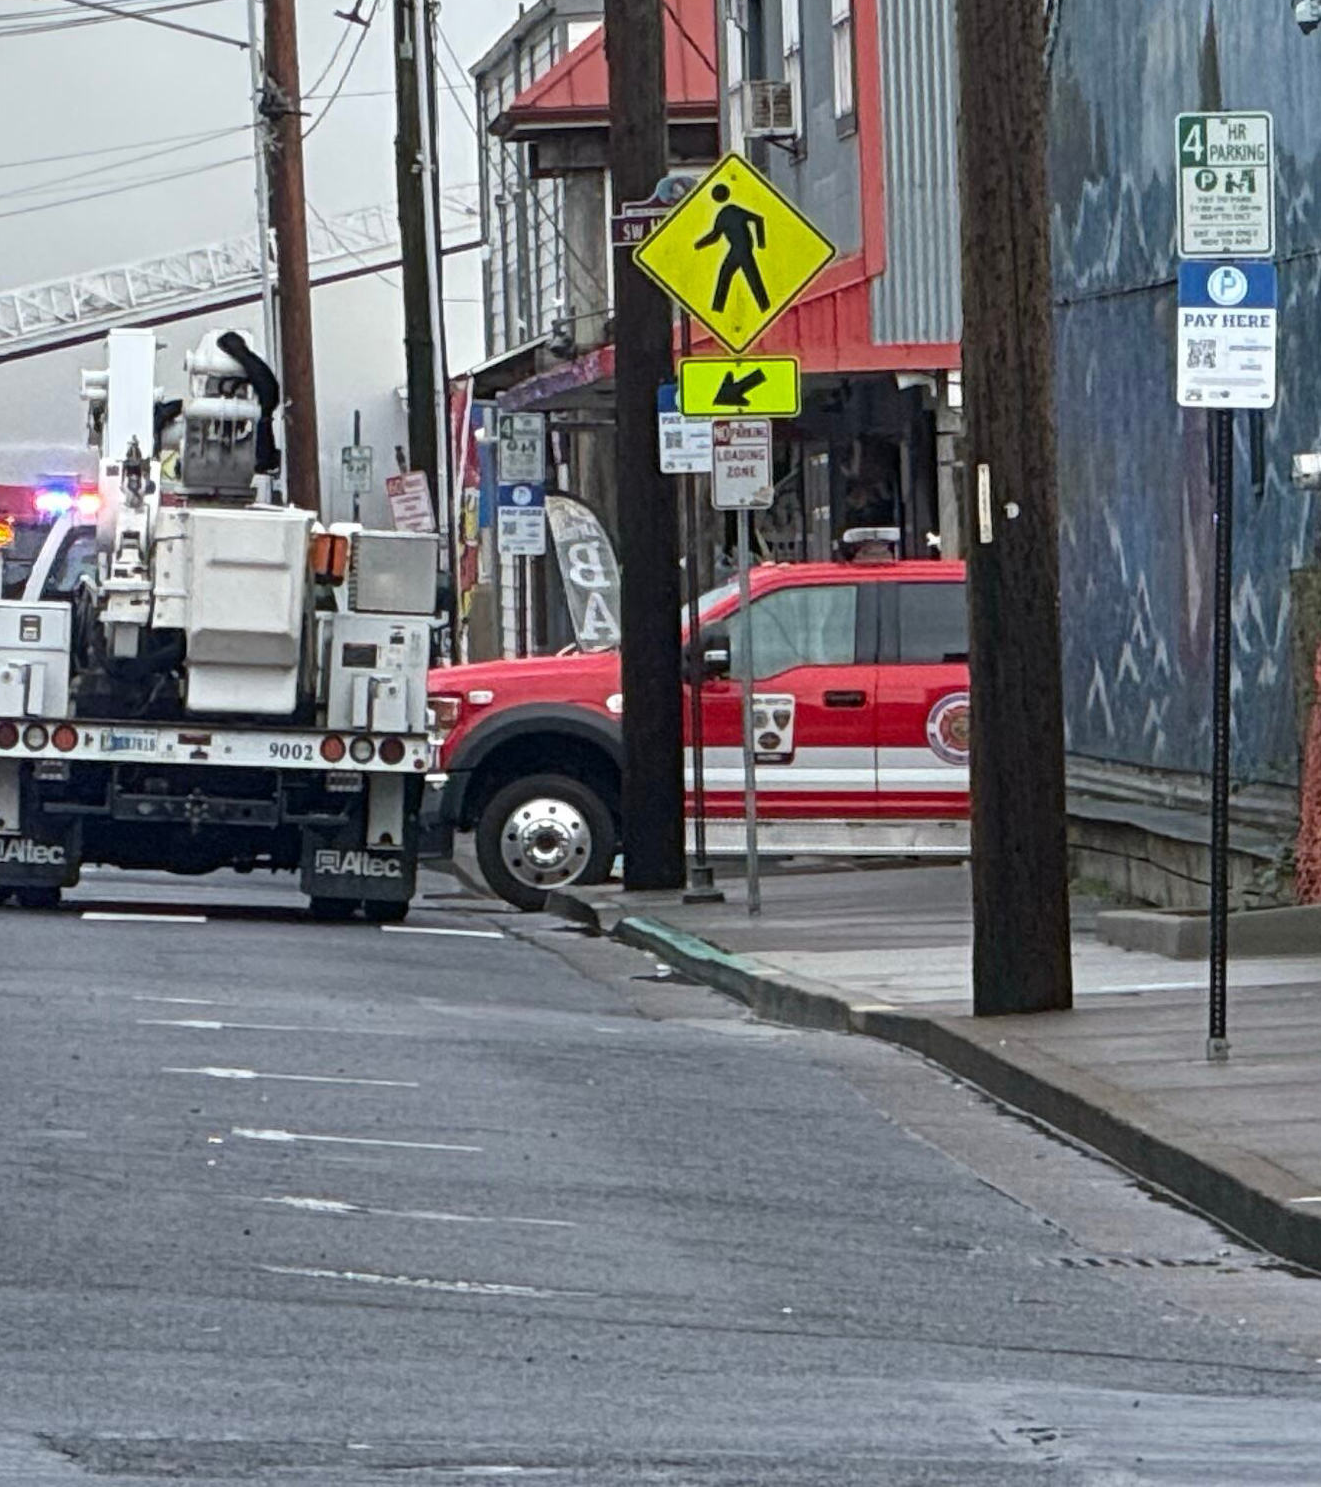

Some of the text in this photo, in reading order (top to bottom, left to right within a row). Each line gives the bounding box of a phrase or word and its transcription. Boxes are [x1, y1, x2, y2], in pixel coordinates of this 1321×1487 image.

[1228, 123, 1246, 140] HR
[1182, 124, 1204, 161] 4
[1209, 144, 1265, 162] PARKING
[622, 222, 645, 241] SW
[1183, 313, 1271, 328] PAY HERE
[501, 416, 513, 438] 4
[717, 450, 766, 462] LOADING
[726, 466, 757, 479] ZONE
[269, 742, 314, 761] 9002
[5, 838, 67, 865] Altec
[340, 850, 402, 878] Altec
